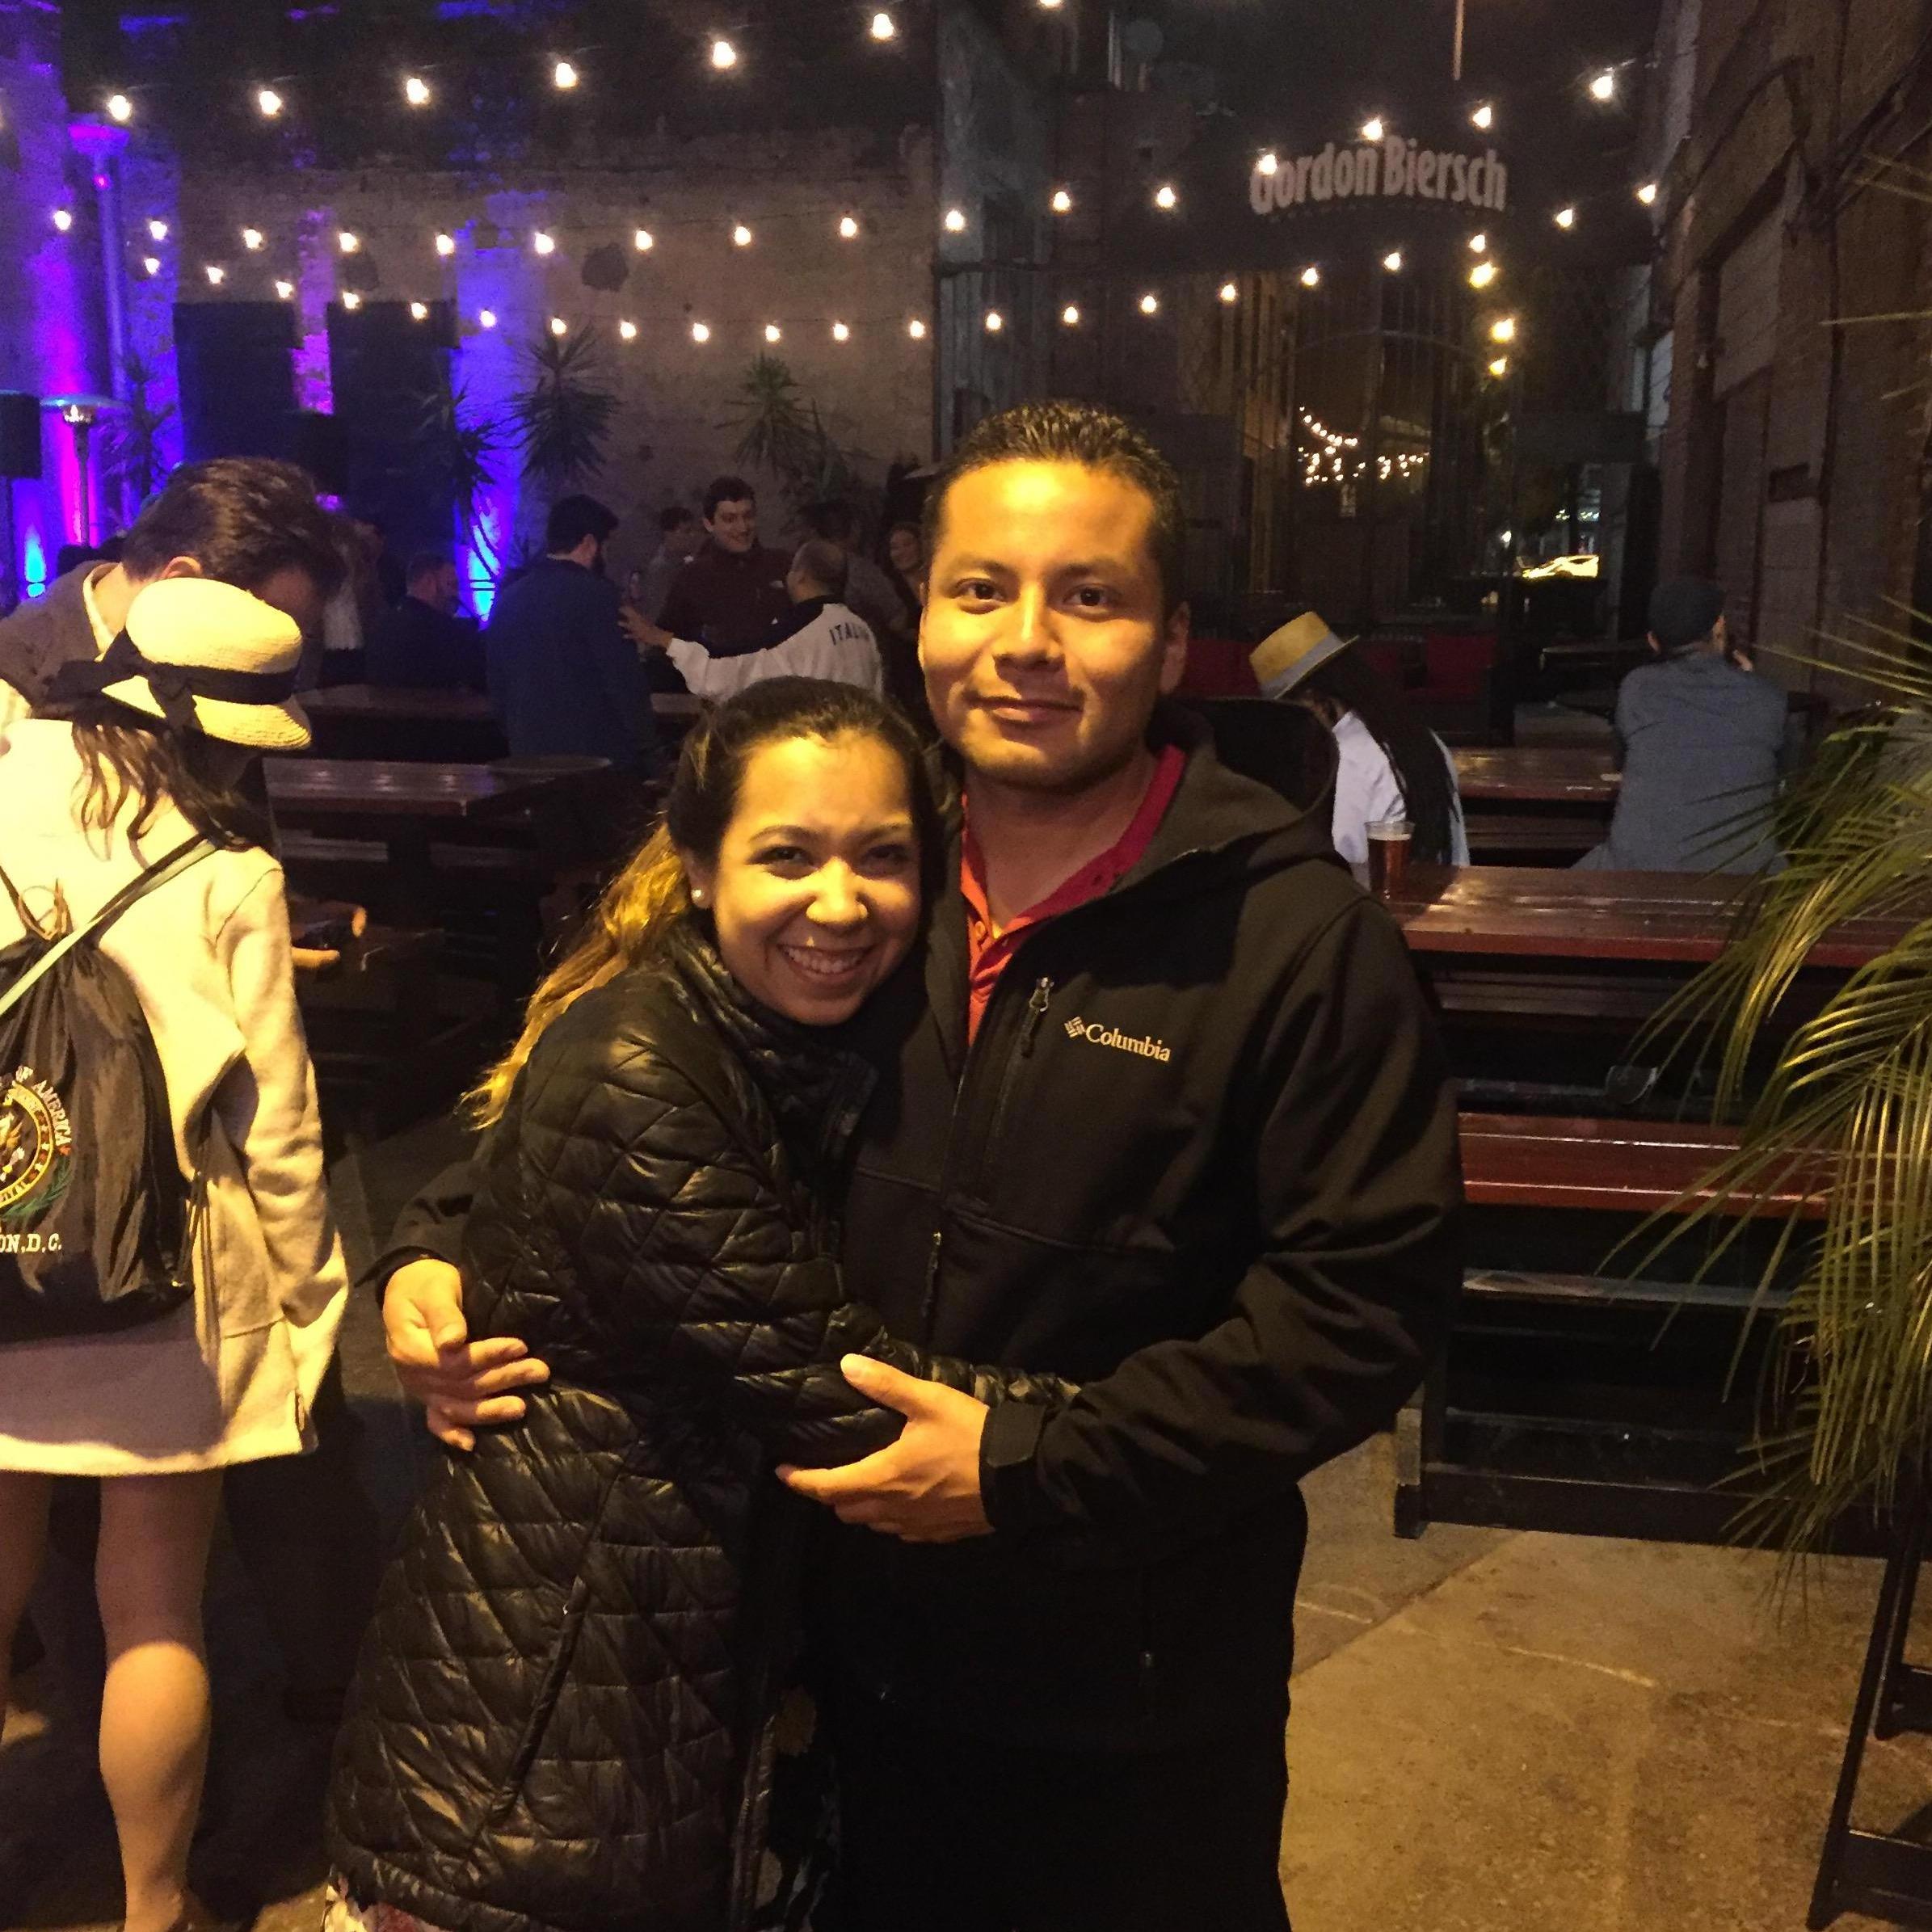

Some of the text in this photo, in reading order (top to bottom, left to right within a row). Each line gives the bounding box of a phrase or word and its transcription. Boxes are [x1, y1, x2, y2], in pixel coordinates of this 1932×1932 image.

[1250, 135, 1508, 215] Gordon Biersch
[829, 622, 870, 646] ITAL
[1086, 1023, 1171, 1063] Columbia
[32, 1080, 72, 1147] AMERICA
